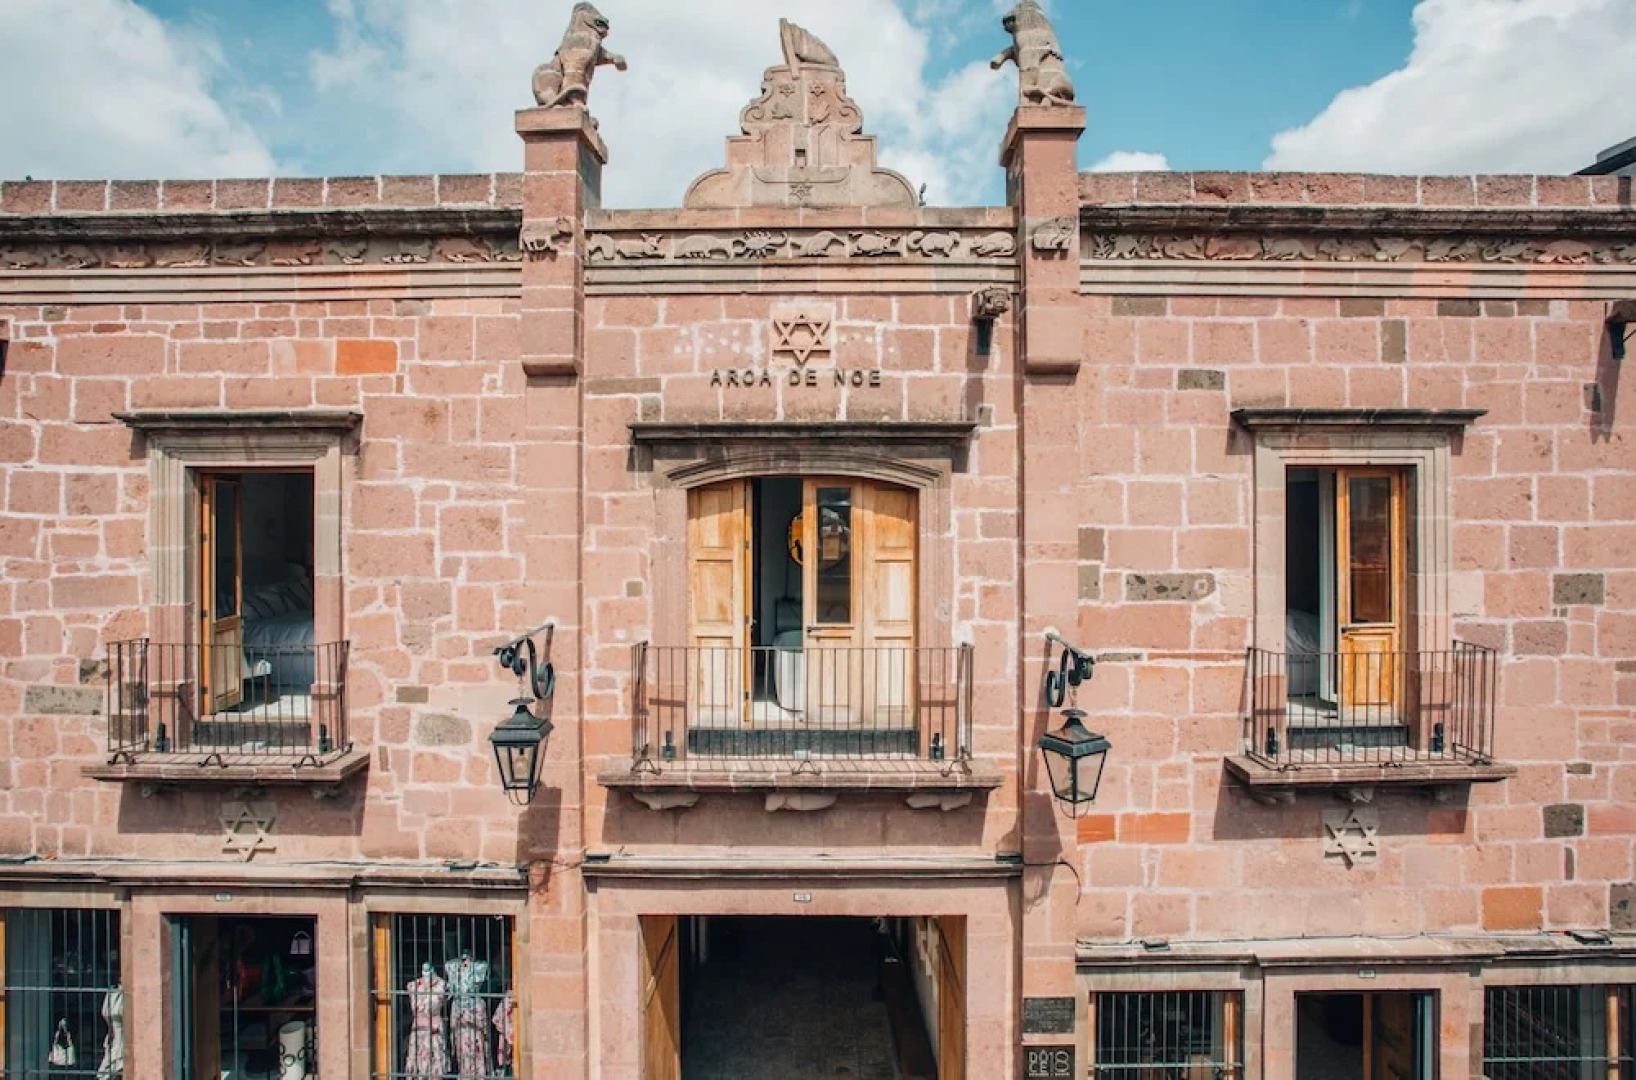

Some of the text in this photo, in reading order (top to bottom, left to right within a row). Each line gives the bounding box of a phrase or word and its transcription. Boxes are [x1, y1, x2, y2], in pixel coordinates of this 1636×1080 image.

[710, 369, 882, 388] ARCA DE NOE
